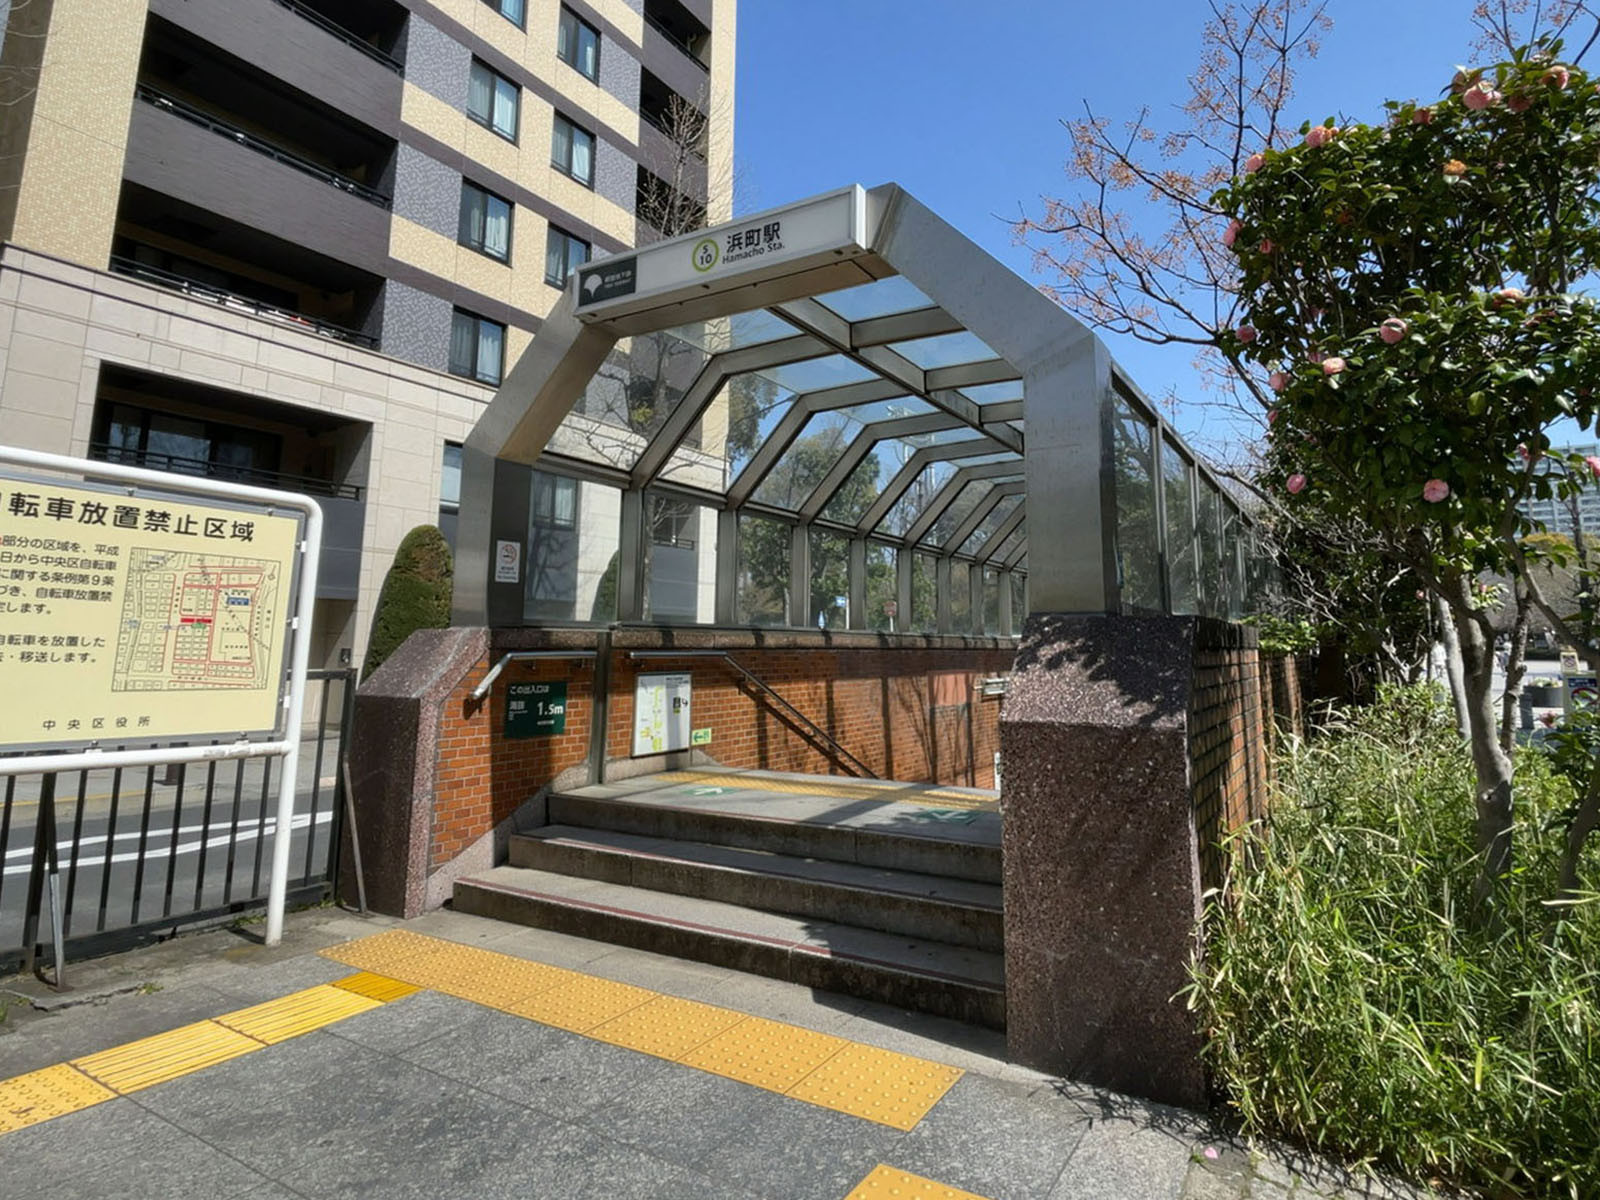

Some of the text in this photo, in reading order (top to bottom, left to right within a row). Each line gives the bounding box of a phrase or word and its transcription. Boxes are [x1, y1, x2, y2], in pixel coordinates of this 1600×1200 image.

[726, 221, 781, 253] 浜町駅
[702, 244, 709, 255] S
[721, 241, 785, 265] Hamacho Sta.
[699, 253, 713, 266] 10
[0, 491, 255, 543] 転車放置禁止区域
[0, 534, 120, 557] 部分の区域を、平成
[537, 701, 564, 716] 1.5m
[42, 715, 151, 731] 中央区役所
